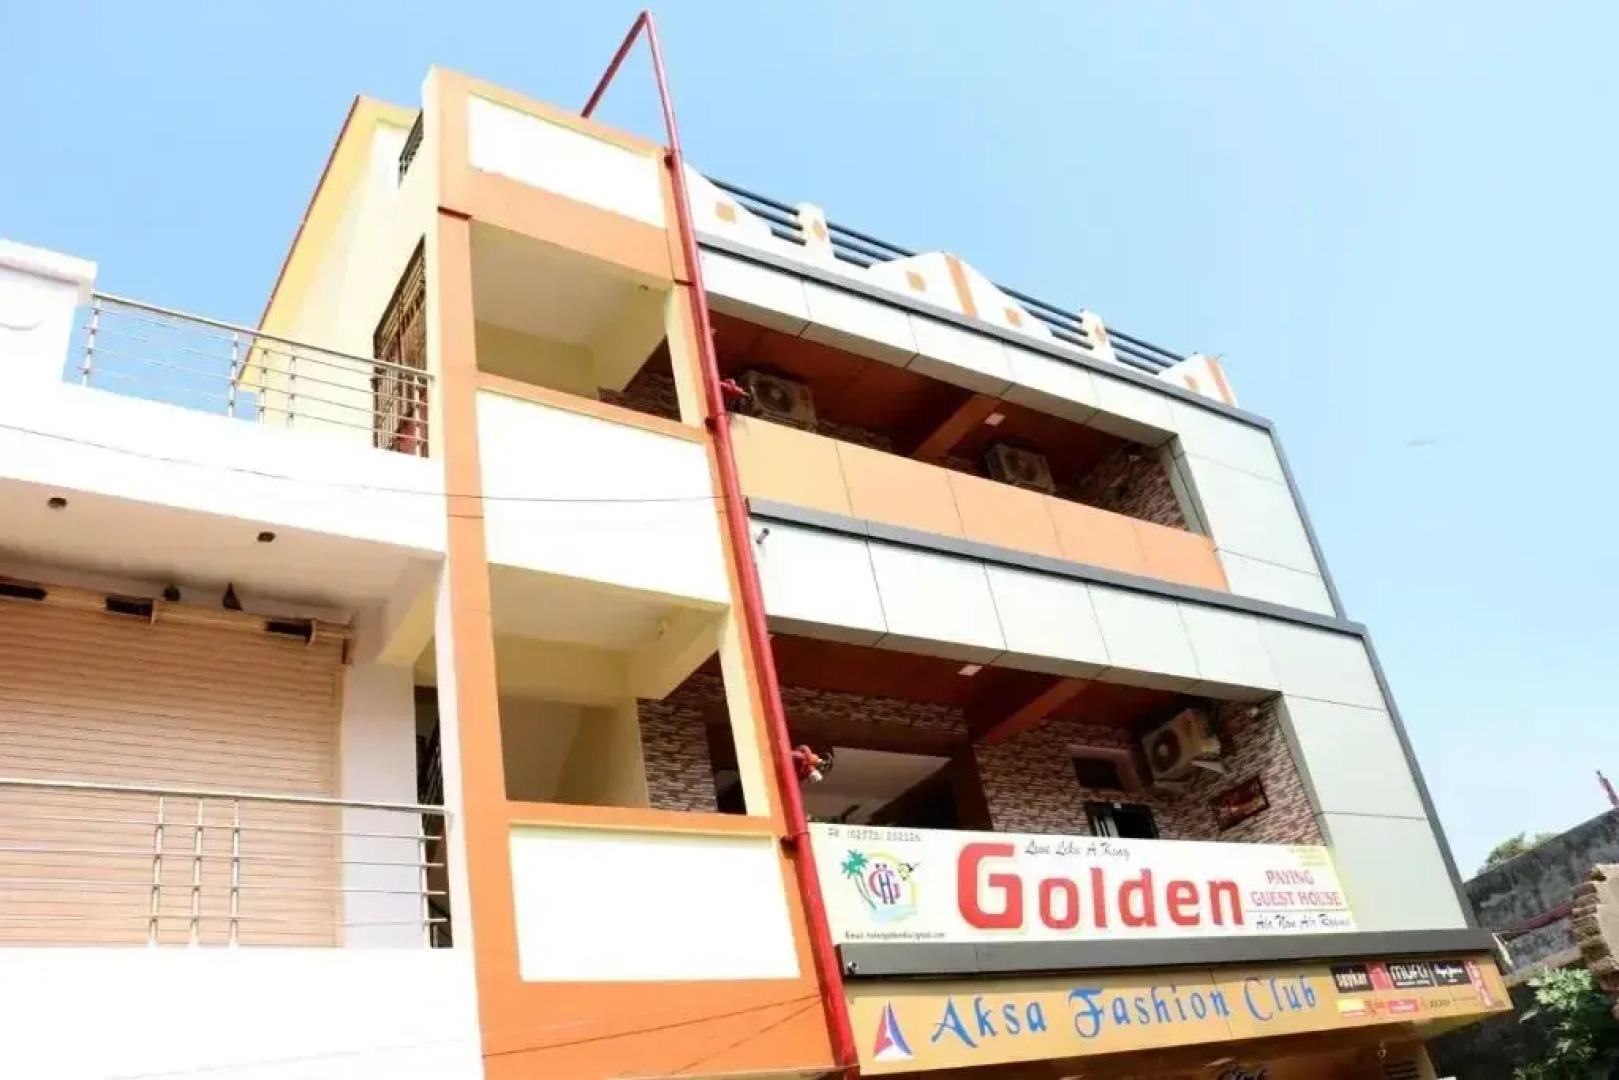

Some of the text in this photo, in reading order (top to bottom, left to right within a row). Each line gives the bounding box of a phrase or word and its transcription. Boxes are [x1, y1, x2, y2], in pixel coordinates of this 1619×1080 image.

[958, 842, 1244, 930] Golden
[1250, 891, 1343, 906] GUEST HOUSE
[1264, 869, 1315, 885] PAYING
[930, 974, 1317, 1048] Aksa Fashion Club
